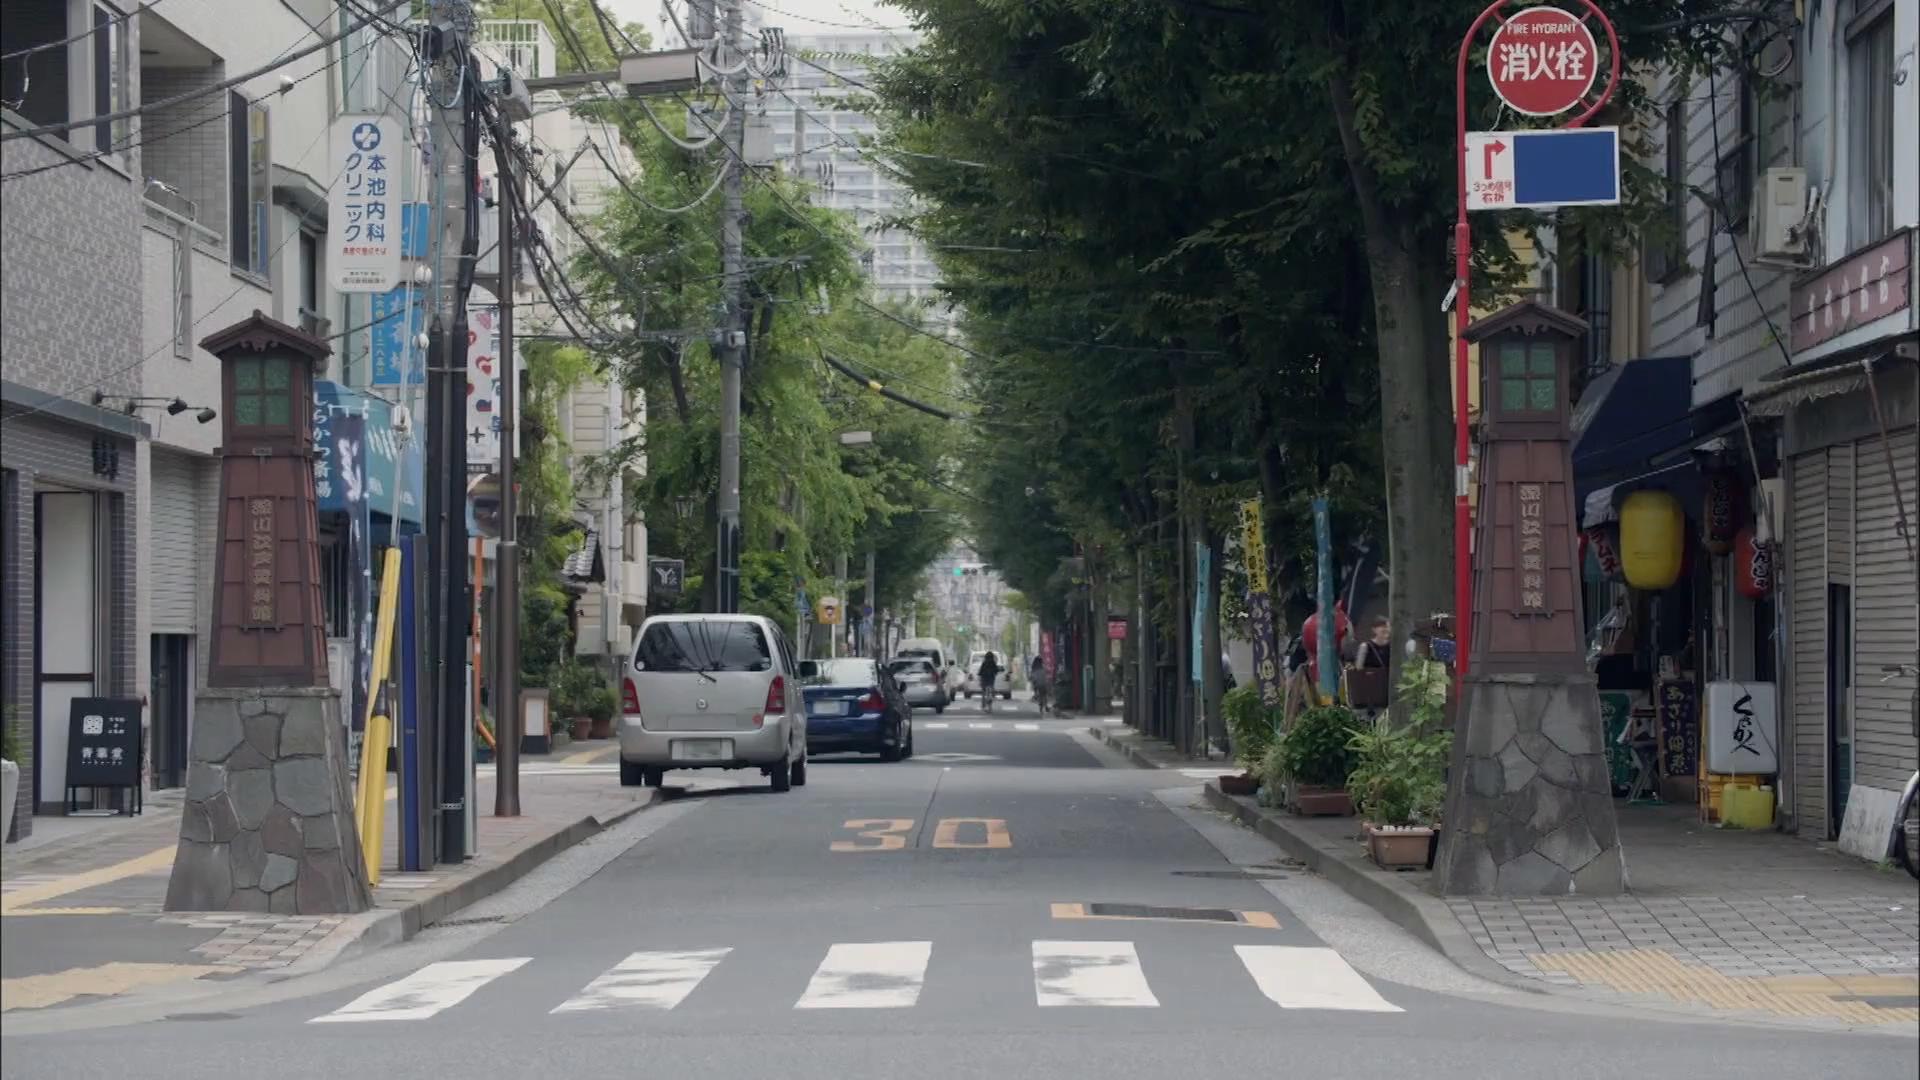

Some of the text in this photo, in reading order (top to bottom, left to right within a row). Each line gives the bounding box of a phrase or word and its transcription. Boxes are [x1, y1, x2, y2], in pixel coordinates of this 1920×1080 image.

[1507, 23, 1576, 34] FIRE HYDRANT
[1500, 40, 1587, 81] 消火栓
[345, 153, 362, 242] クリニック
[367, 154, 386, 242] 本池内科
[829, 818, 1012, 851] 30
